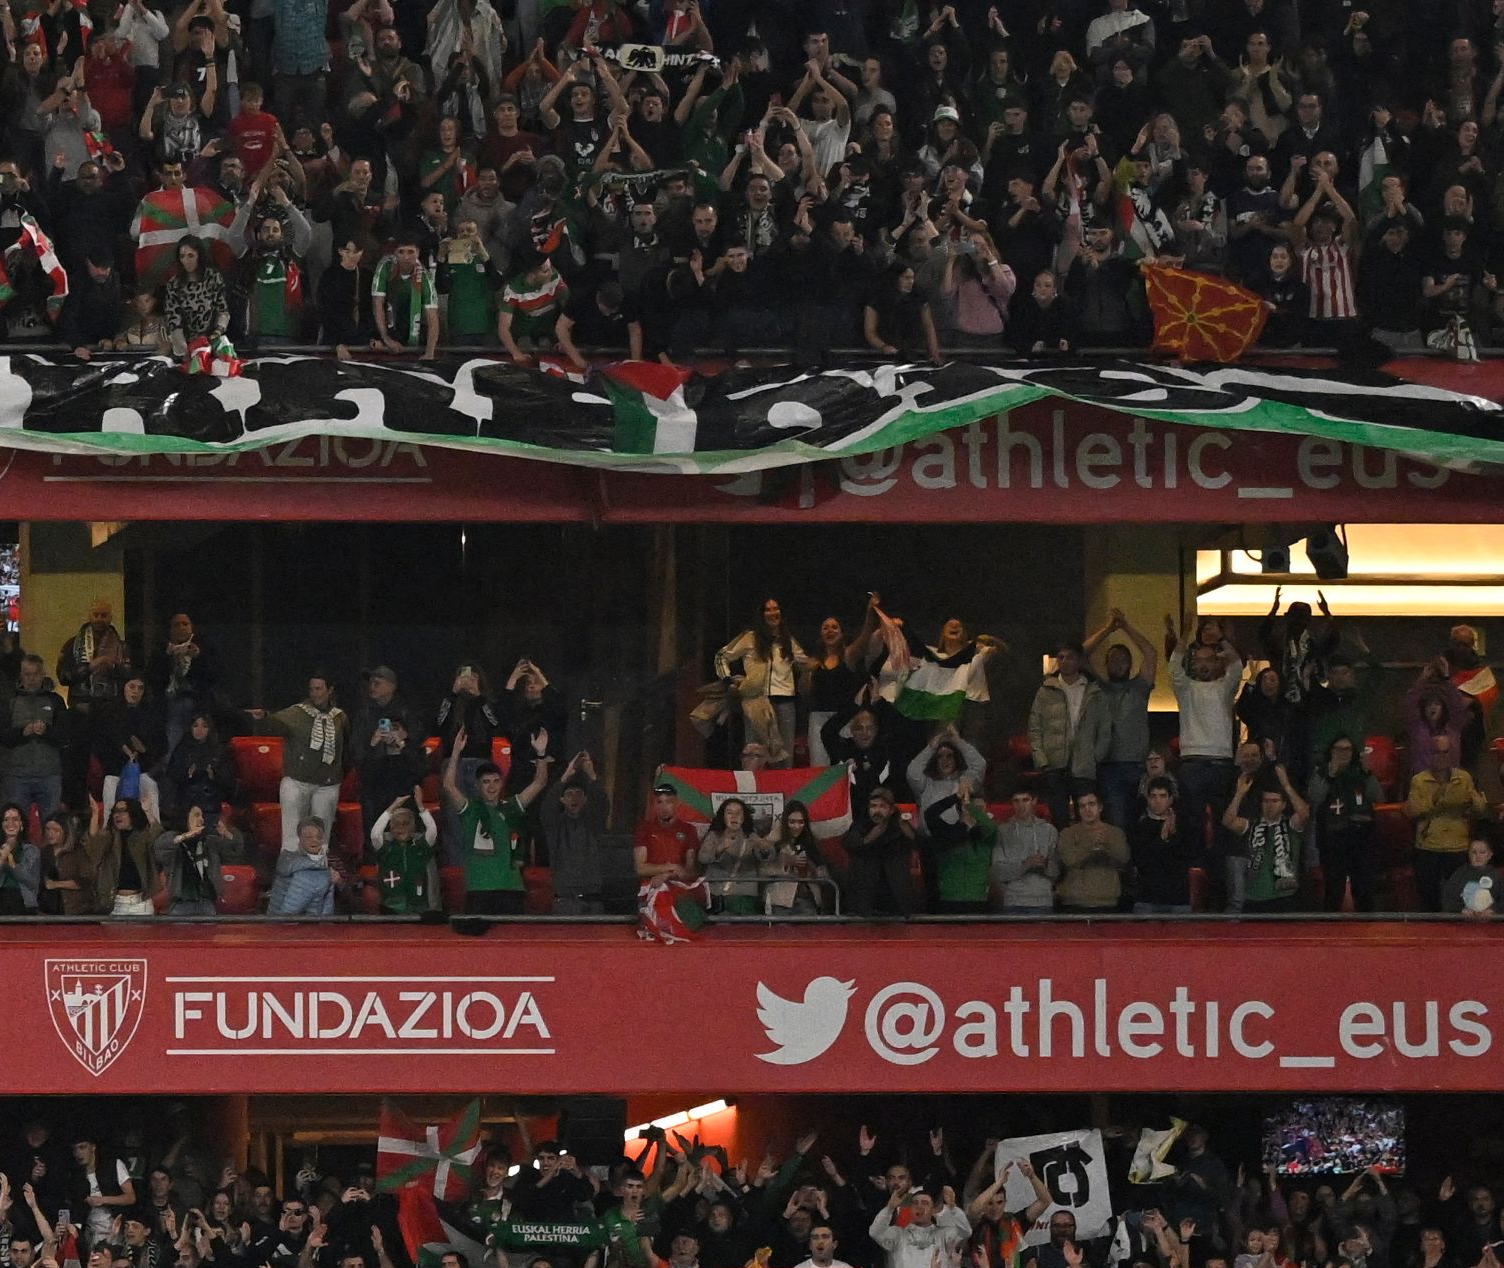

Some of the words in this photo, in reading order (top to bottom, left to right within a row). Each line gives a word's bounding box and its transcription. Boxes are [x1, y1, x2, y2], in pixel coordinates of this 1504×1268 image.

[53, 963, 106, 973] ATHLETIC
[109, 963, 141, 973] CLUB
[175, 991, 551, 1040] FUNDAZIOA
[75, 1039, 119, 1071] BILBAO
[512, 1225, 551, 1235] EUSKAL
[552, 1226, 591, 1235] HERRIA
[524, 1234, 580, 1244] PALESTINA
